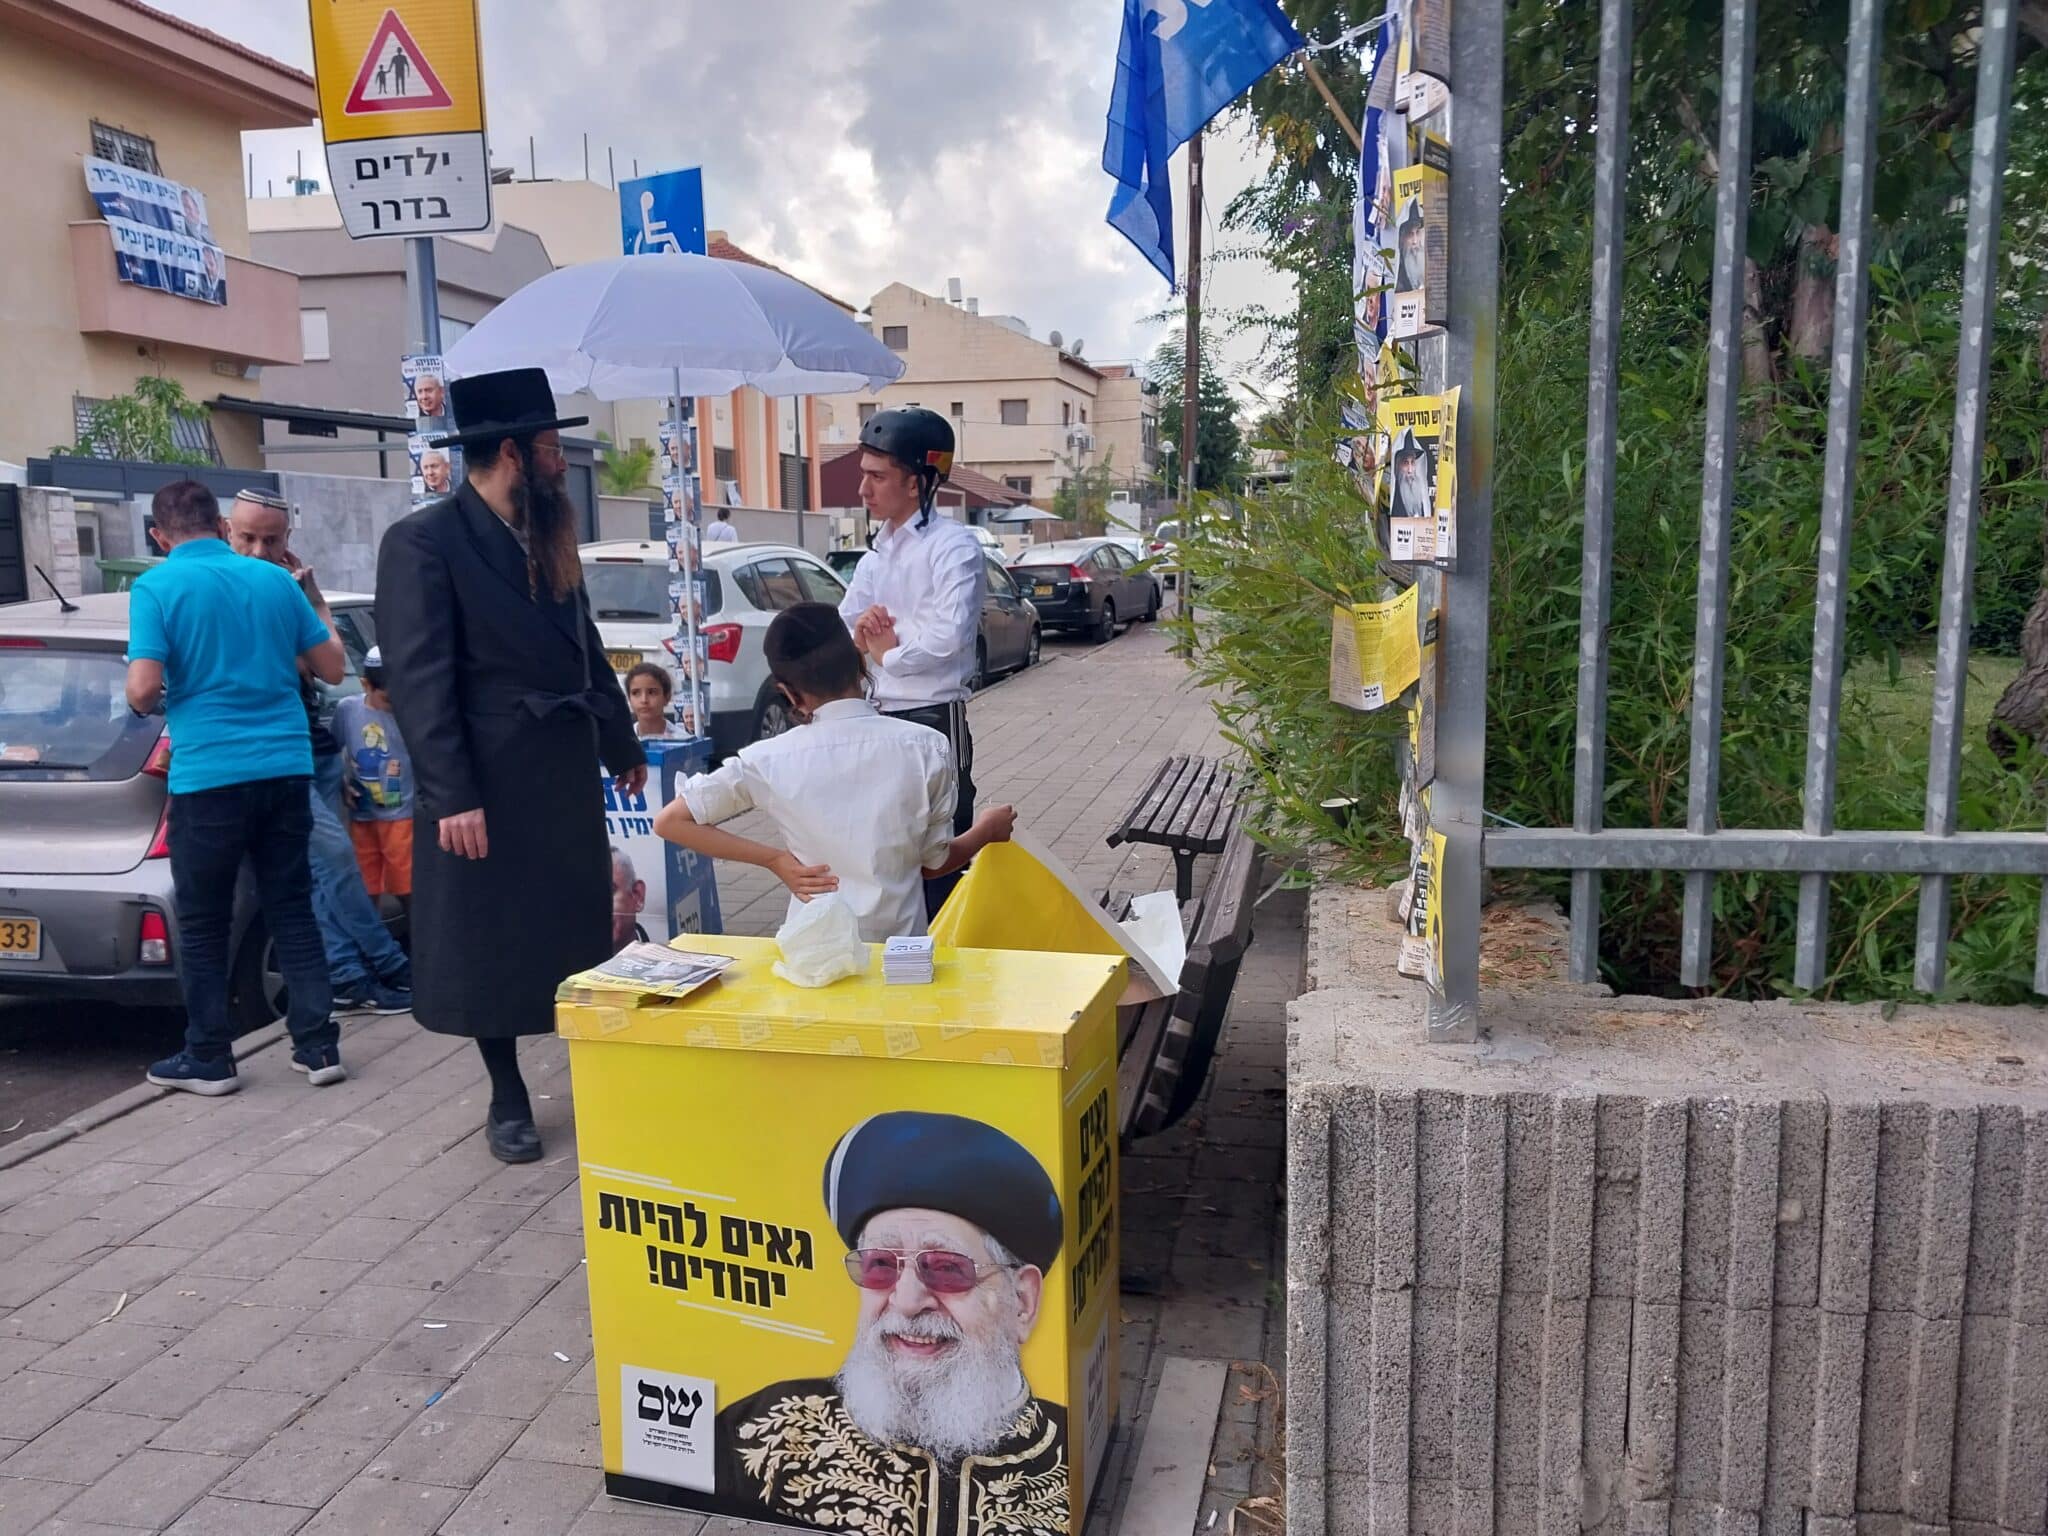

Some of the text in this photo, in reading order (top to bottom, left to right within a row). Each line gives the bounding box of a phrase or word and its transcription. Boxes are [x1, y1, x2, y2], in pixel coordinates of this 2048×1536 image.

[355, 147, 450, 181] ילדים
[1399, 178, 1423, 198] שים!
[361, 197, 451, 230] בדרך
[1395, 411, 1430, 428] קודשים!
[1080, 1087, 1108, 1172] גאים
[1079, 1141, 1111, 1246] להיות
[599, 1191, 814, 1271] גאים להיות
[646, 1245, 786, 1308] יהודים!
[1072, 1203, 1114, 1326] יהודים!
